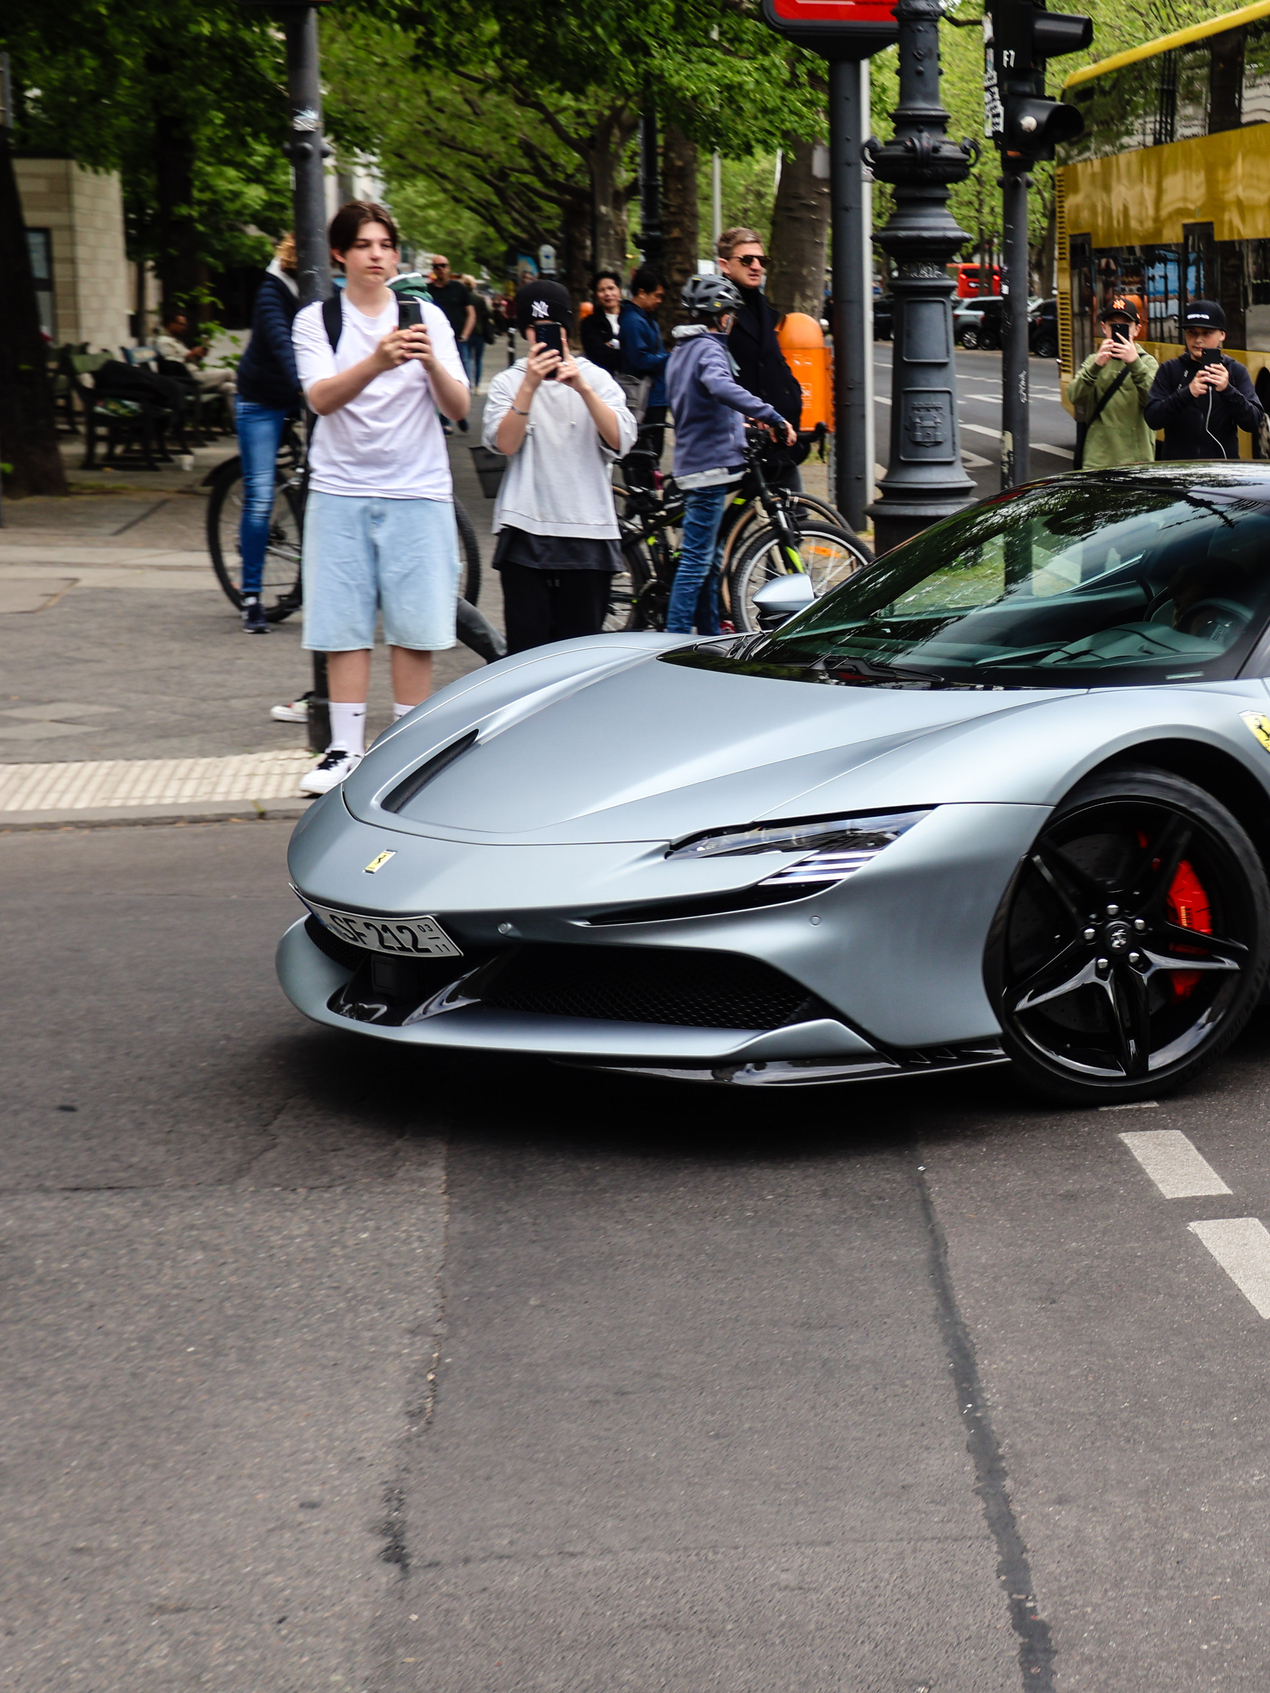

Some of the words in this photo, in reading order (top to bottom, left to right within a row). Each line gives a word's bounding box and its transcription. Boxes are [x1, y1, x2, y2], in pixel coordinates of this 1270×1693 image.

[329, 914, 367, 945] SF
[363, 921, 433, 954] 212
[416, 923, 434, 933] 03
